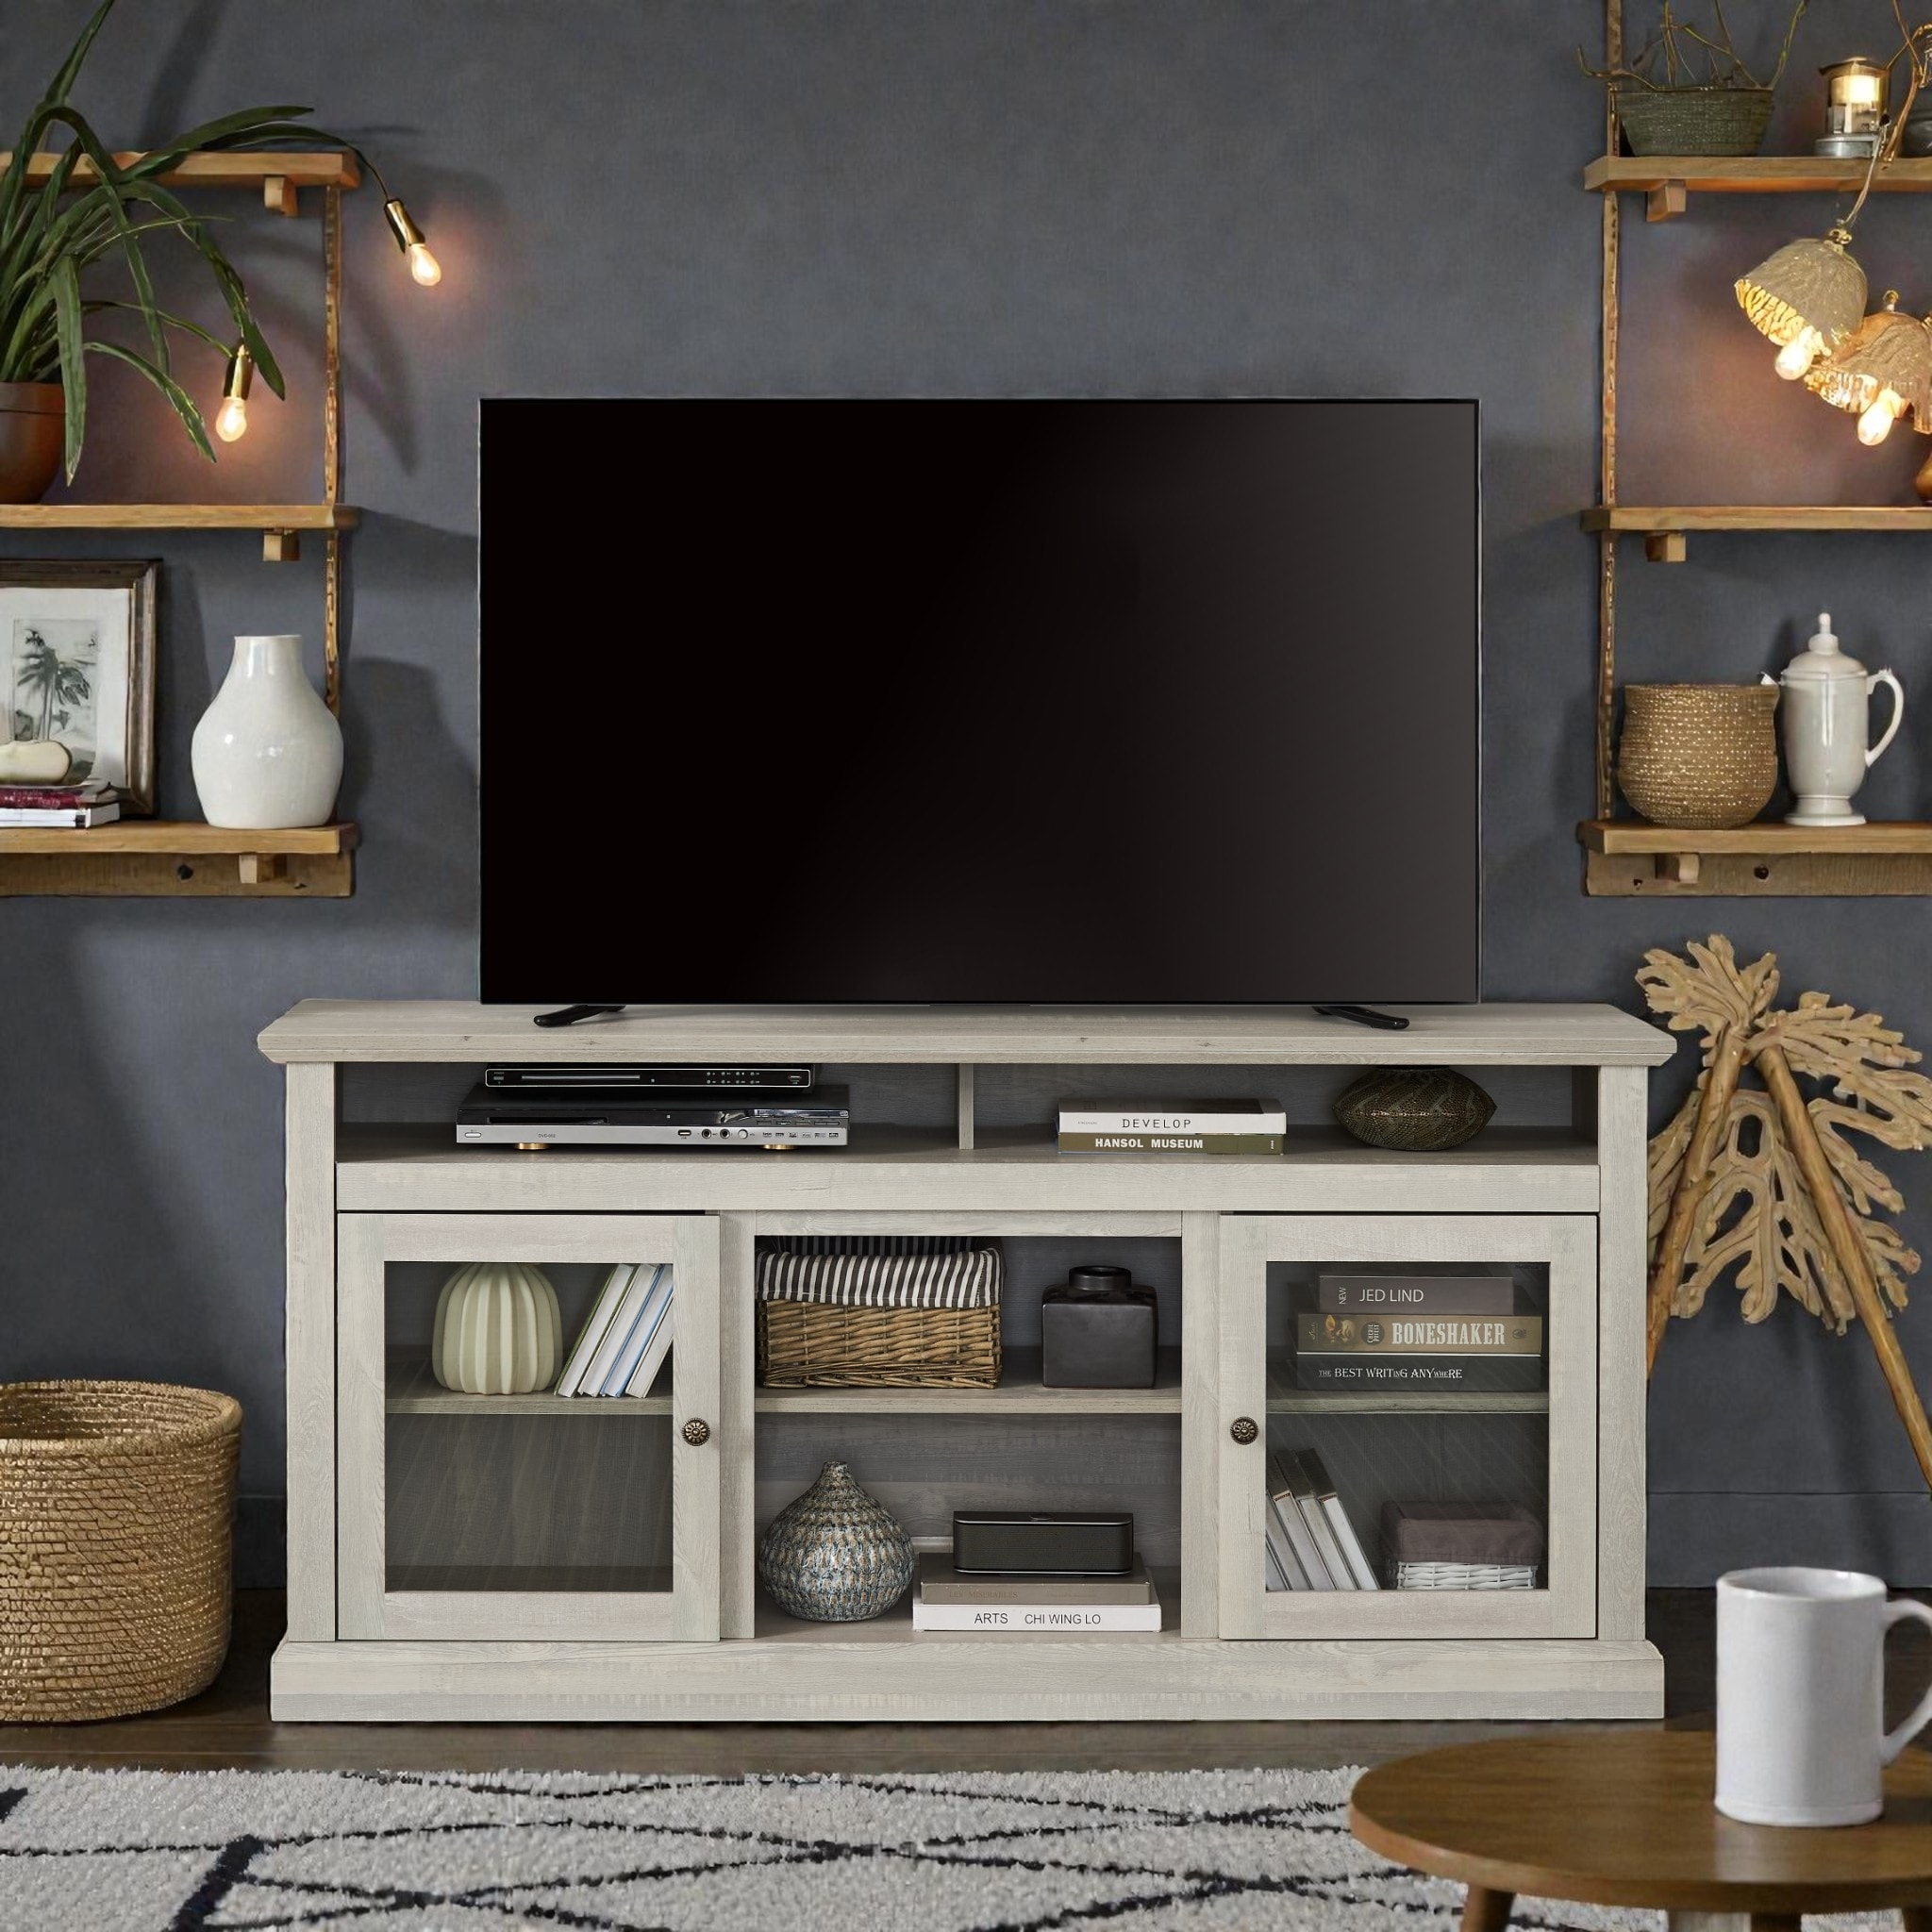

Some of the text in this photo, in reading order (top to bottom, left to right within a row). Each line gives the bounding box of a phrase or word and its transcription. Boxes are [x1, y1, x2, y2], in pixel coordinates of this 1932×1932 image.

[1122, 1118, 1191, 1128] DEVELOP
[1094, 1138, 1203, 1149] HANSOL MUSEUM
[1339, 1287, 1347, 1305] NEW
[1358, 1289, 1424, 1302] JED LIND
[1391, 1322, 1506, 1345] BONESHAKER
[1319, 1369, 1332, 1378] THE
[1334, 1367, 1364, 1378] BEST
[974, 1612, 1008, 1624] ARTS
[1024, 1613, 1102, 1624] CHI WING LO
